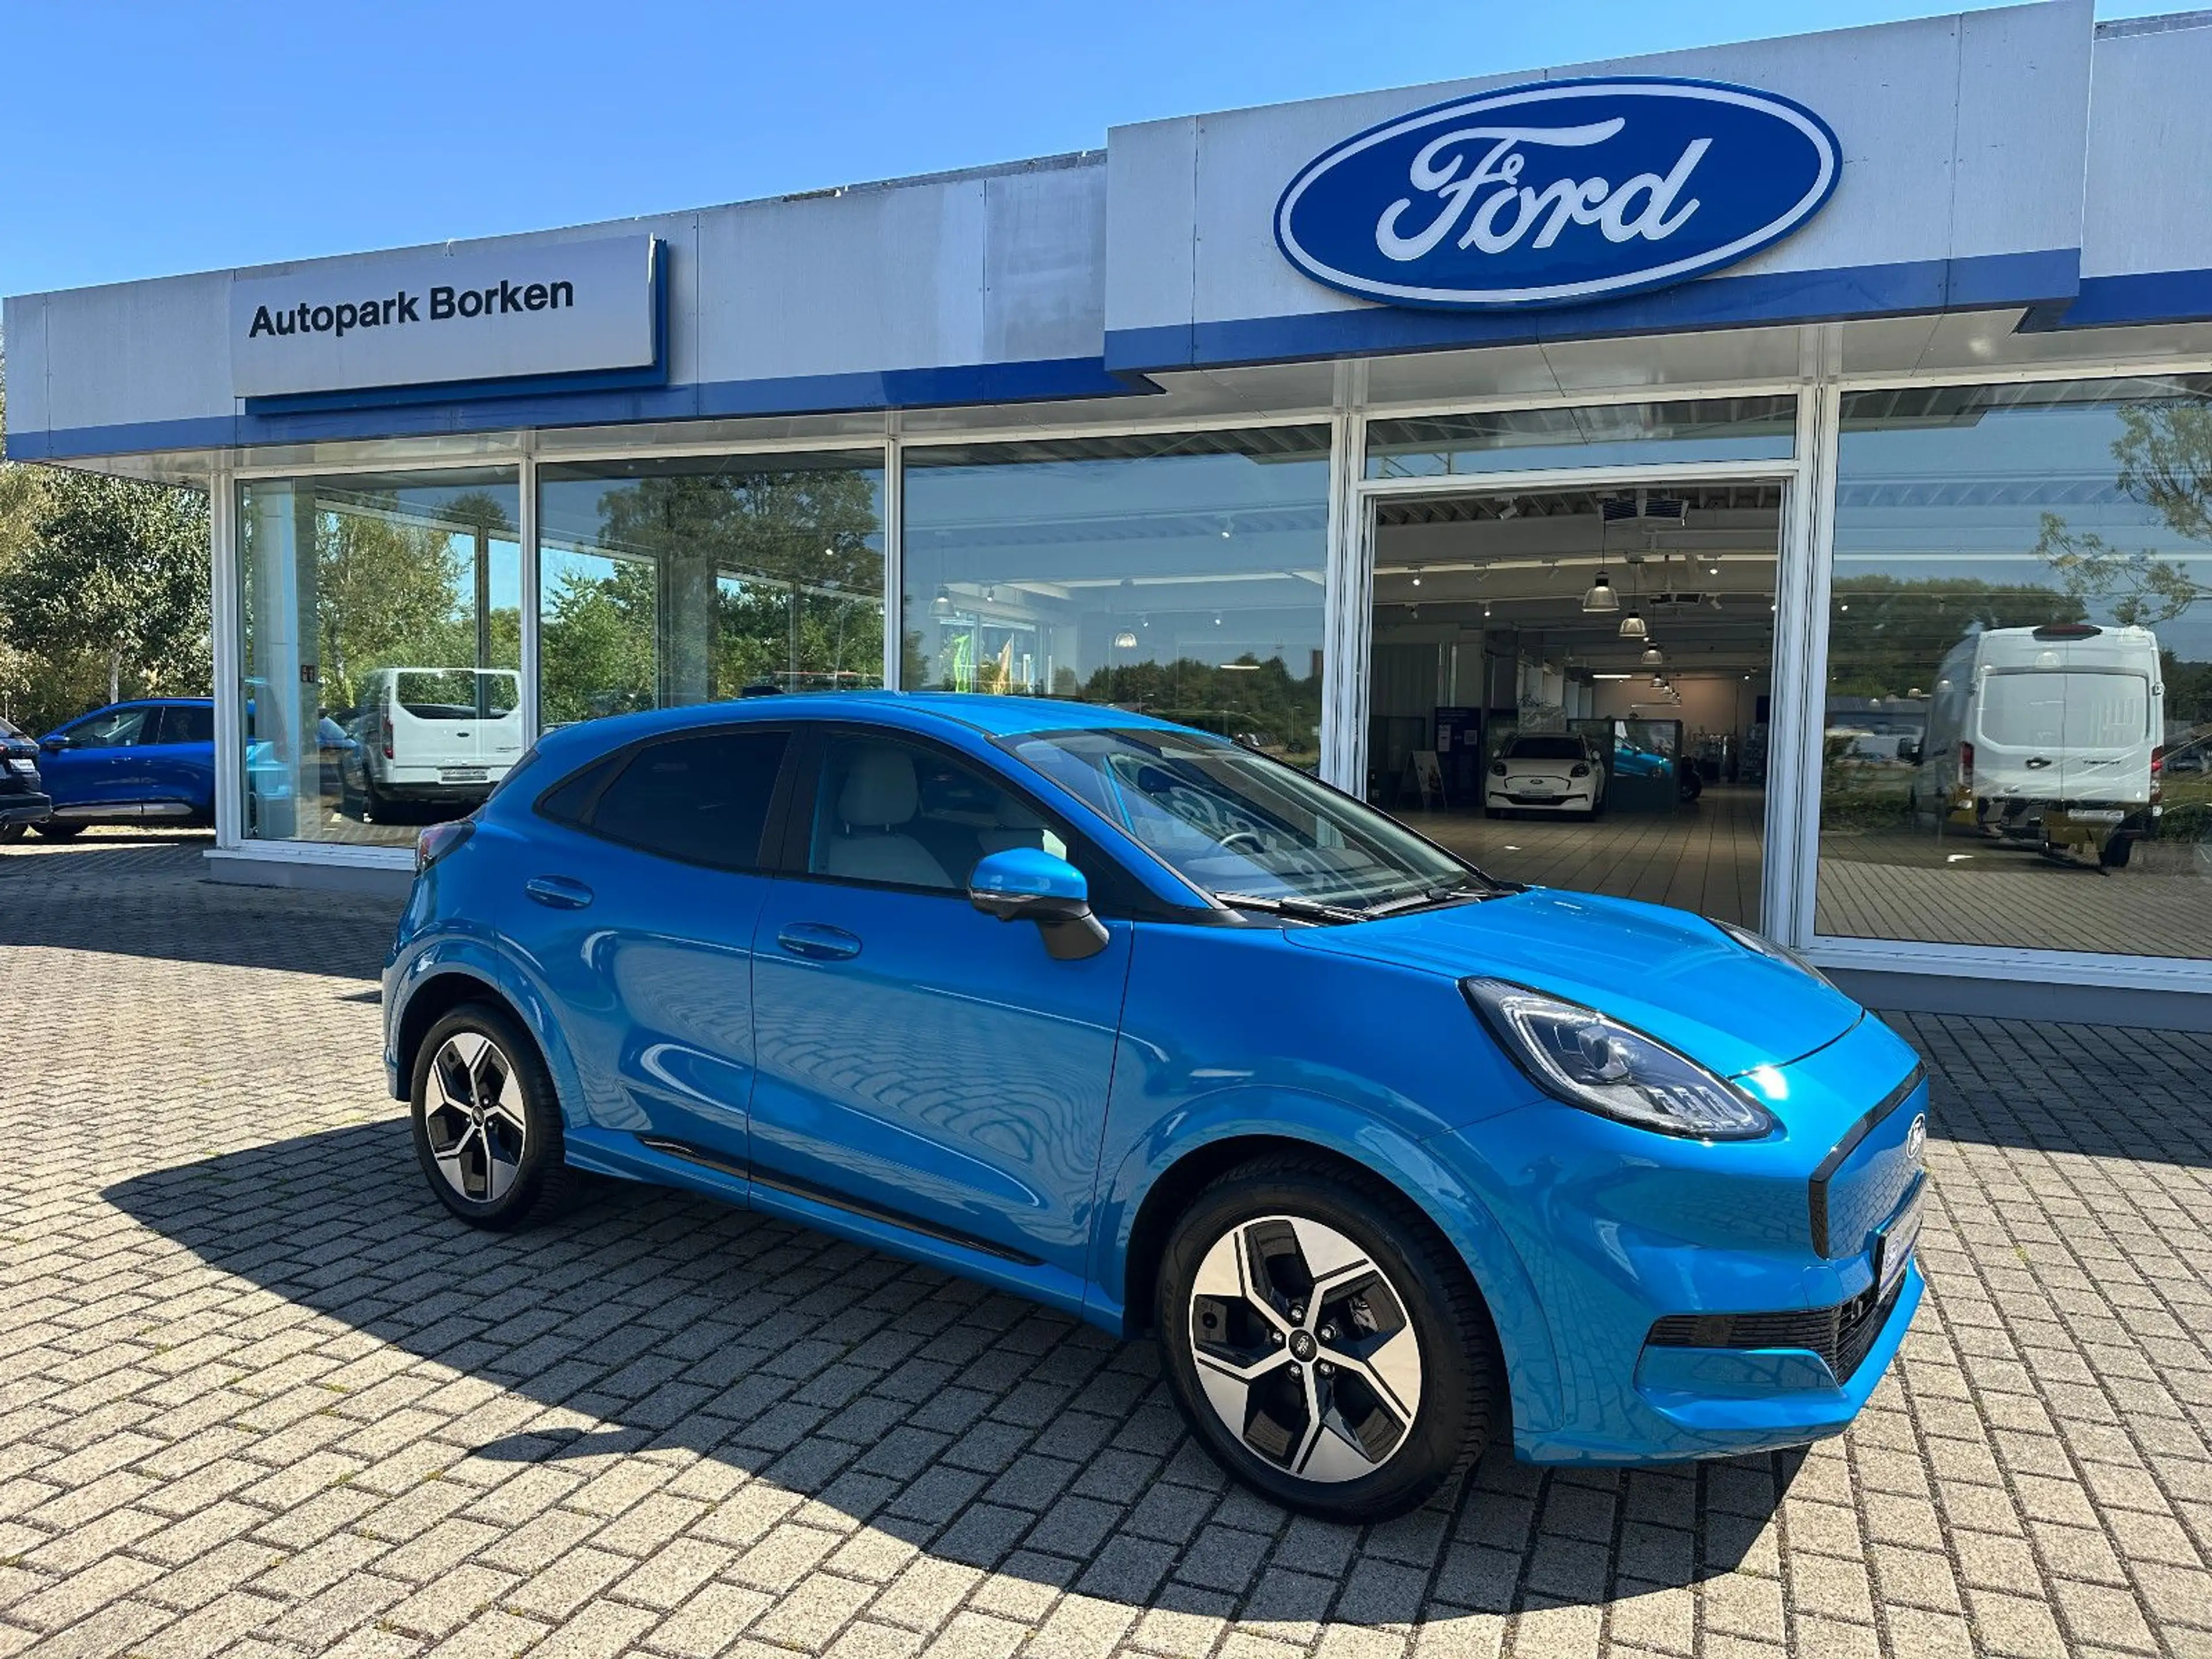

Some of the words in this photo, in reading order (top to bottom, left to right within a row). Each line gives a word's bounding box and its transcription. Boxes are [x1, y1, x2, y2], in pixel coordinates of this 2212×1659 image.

[1376, 117, 1713, 262] Ford
[248, 290, 421, 338] Autopark
[430, 278, 574, 321] Borken
